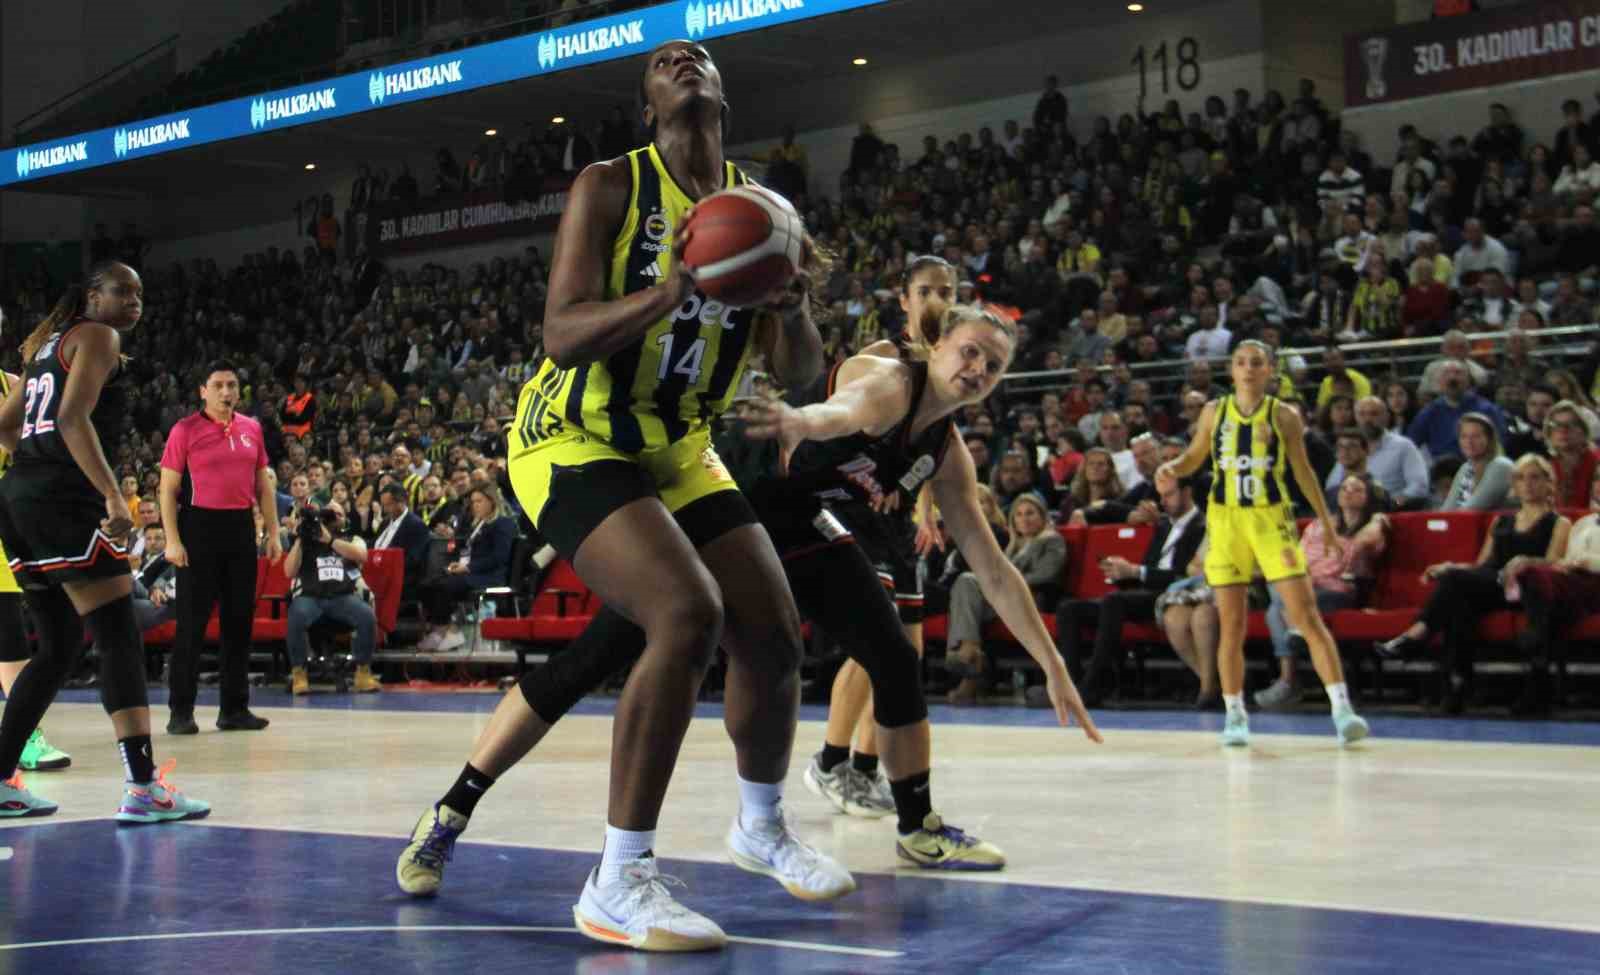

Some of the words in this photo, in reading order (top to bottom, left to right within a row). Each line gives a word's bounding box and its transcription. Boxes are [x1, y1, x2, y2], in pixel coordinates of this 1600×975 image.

[555, 20, 644, 60] HALKBANK
[1413, 42, 1453, 76] 30.
[1456, 20, 1575, 68] KADINLAR
[1580, 15, 1600, 48] C
[385, 60, 462, 96] HALKBANK
[1130, 37, 1200, 97] 118
[265, 88, 336, 121] HALKBANK
[127, 118, 190, 151] HALKBANK
[28, 141, 87, 171] HALKBANK
[656, 333, 706, 385] 14
[21, 372, 55, 440] 22
[1234, 475, 1262, 500] 10
